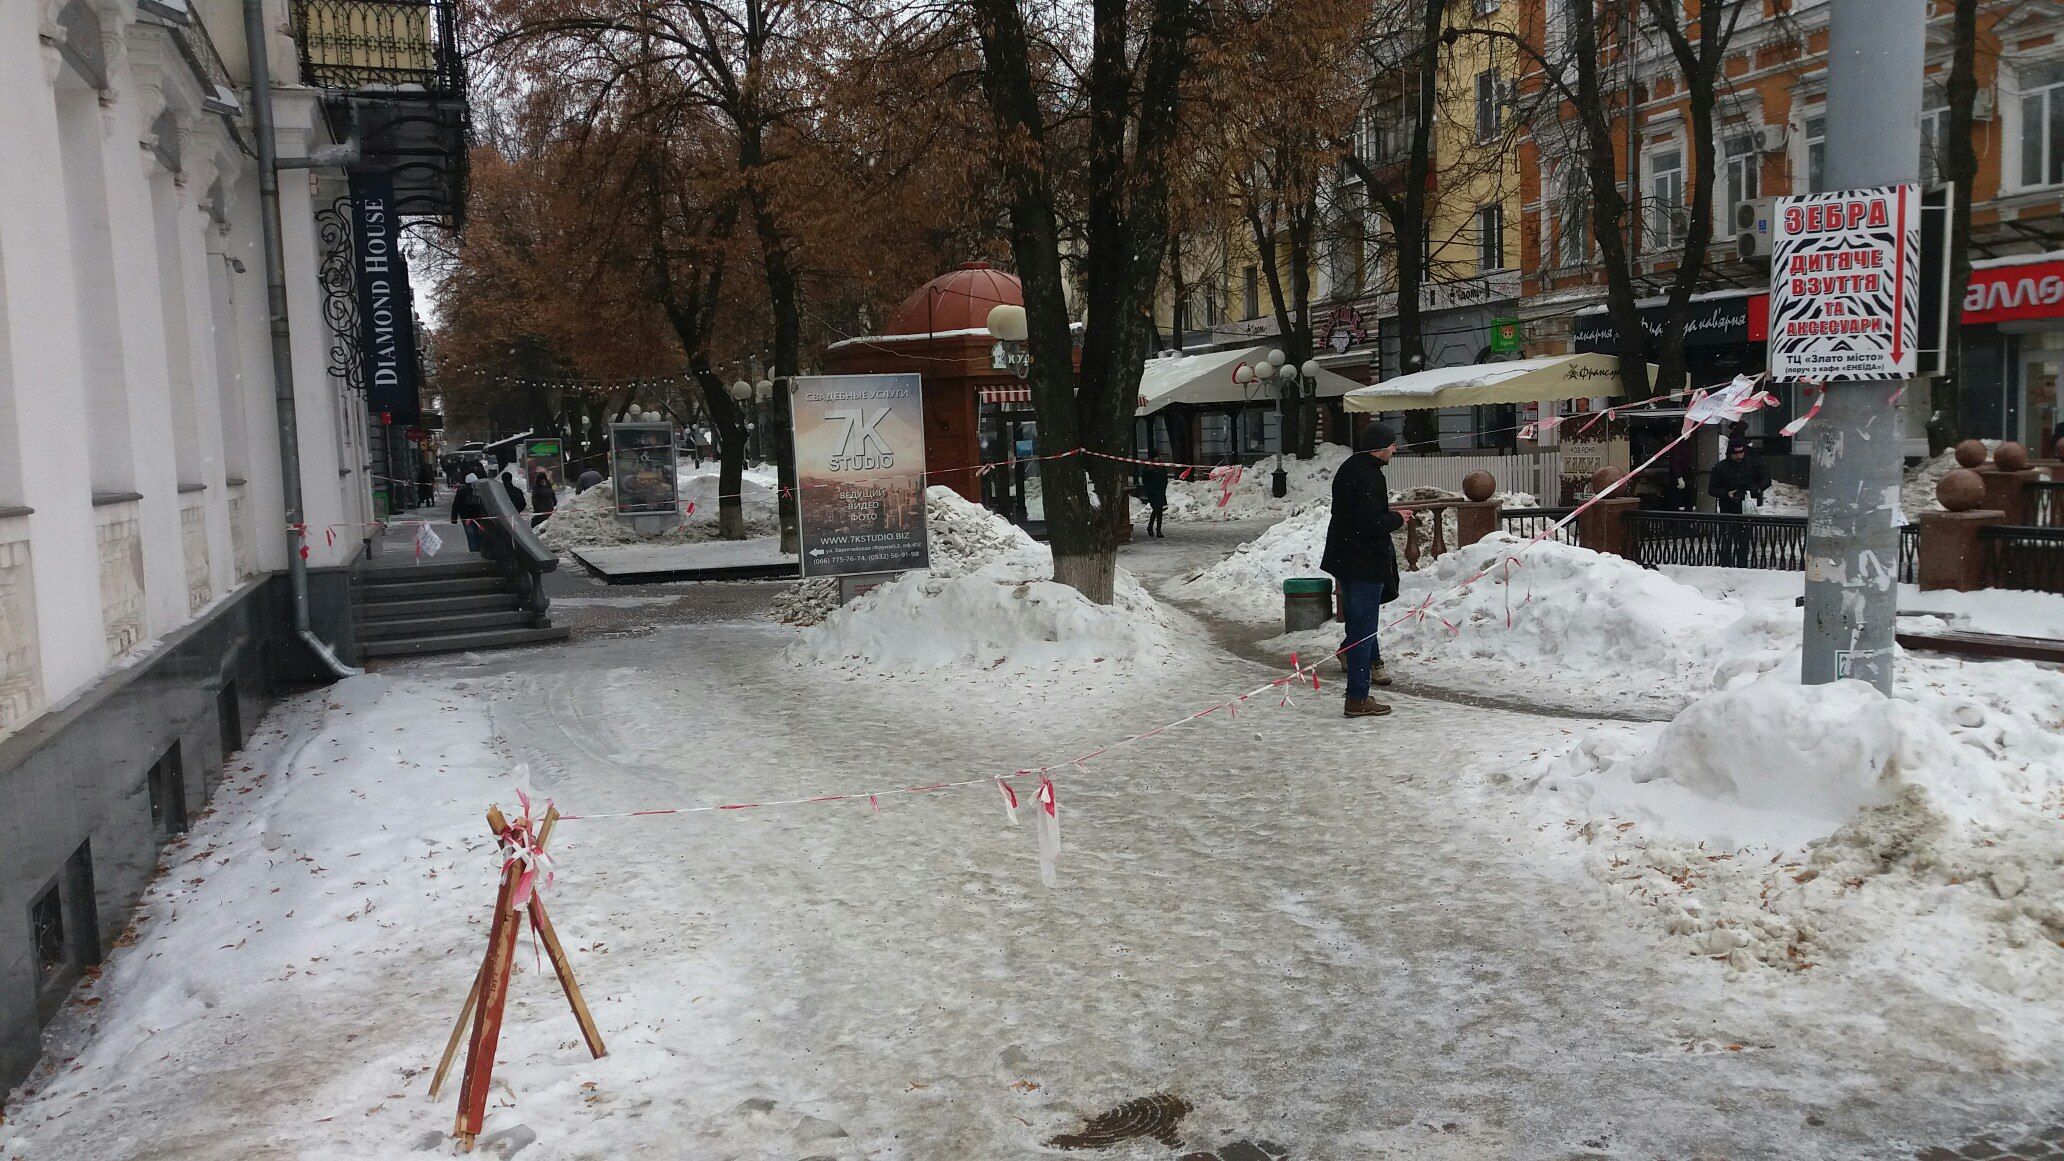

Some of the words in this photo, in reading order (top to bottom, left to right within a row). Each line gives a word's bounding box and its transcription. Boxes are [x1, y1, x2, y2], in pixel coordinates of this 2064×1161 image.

[1784, 199, 1889, 234] ЗЕБРА
[1789, 249, 1883, 276] ДИТЯЧЕ
[1791, 273, 1880, 297] ВЗУТТЯ
[1824, 301, 1845, 316] ТА
[1786, 317, 1883, 336] АКСЕСУАРИ
[1786, 355, 1802, 365] ТЦ
[1804, 354, 1844, 364] «Злато
[1846, 352, 1883, 363] місто»
[1785, 366, 1810, 374] (поруч
[1819, 365, 1840, 373] кафе
[805, 391, 868, 402] СВАДЕБНЫЕ
[870, 389, 909, 400] УСЛУГИ
[824, 407, 894, 457] 7K
[829, 455, 894, 472] STUDIO
[839, 487, 885, 500] ВЕДУЩИЙ
[848, 502, 879, 511] ВИДЕО
[850, 513, 878, 522] ФОТО
[820, 532, 910, 545] WWW.7KSTUDIO.BIZ
[813, 557, 830, 565] (066)
